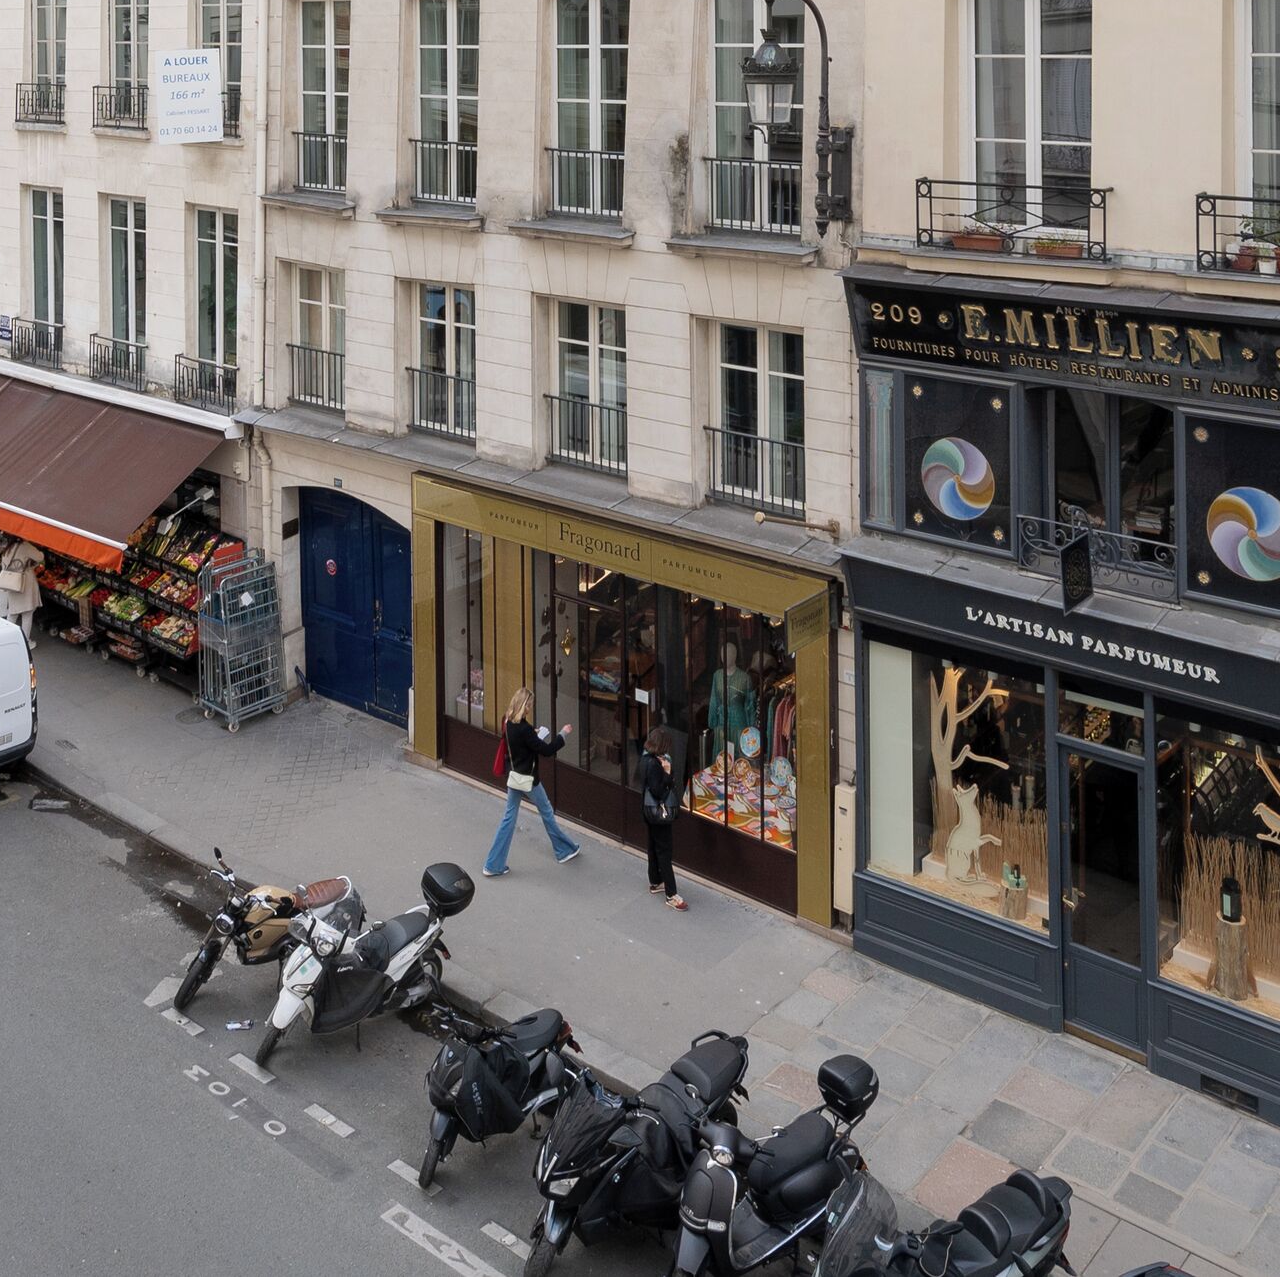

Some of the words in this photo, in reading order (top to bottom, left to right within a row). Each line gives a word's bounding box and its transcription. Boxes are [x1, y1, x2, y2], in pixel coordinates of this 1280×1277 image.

[163, 58, 172, 67] A
[174, 56, 208, 66] LOUER
[162, 73, 211, 84] BUREAUX
[170, 90, 188, 100] 166
[159, 128, 170, 136] 01
[184, 126, 194, 134] 60
[197, 125, 206, 133] 14
[870, 302, 922, 325] 209
[960, 303, 1222, 366] E.MILLIEN
[872, 337, 956, 359] FOURNITURES
[965, 348, 1001, 364] POUR
[1009, 352, 1060, 371] HÔTELS
[1070, 360, 1171, 388] RESTAURANTS
[1181, 377, 1201, 392] ET
[489, 511, 540, 531] PARFUMEUR
[558, 521, 642, 562] Fragonard
[662, 558, 723, 581] PARFUMEUR
[965, 605, 1075, 647] L'ARTISAN
[1080, 634, 1221, 685] PARFUMEUR
